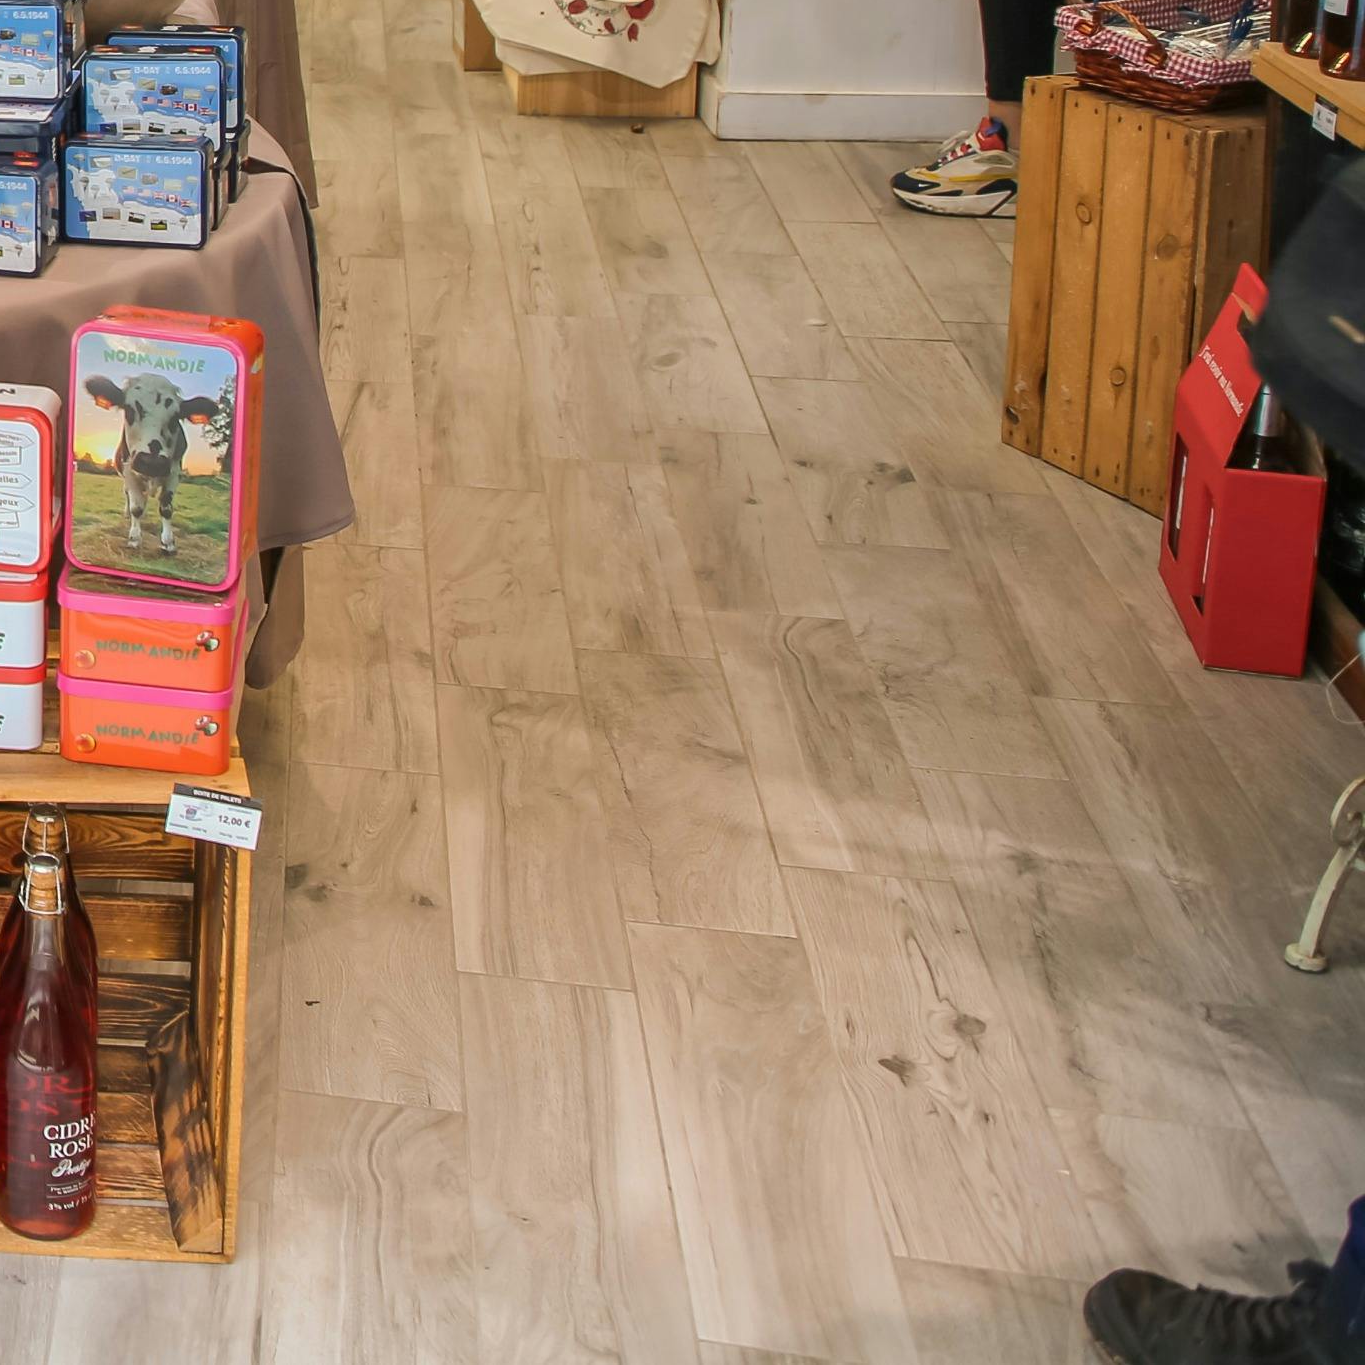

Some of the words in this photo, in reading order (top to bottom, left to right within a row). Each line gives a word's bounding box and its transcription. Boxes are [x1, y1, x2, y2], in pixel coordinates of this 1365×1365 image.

[102, 348, 206, 375] NORMANDIE
[95, 637, 200, 663] NORMANDIE
[95, 721, 200, 747] NORMANDIE
[217, 812, 242, 826] 12,00
[243, 817, 252, 828] €
[63, 1201, 75, 1210] vol
